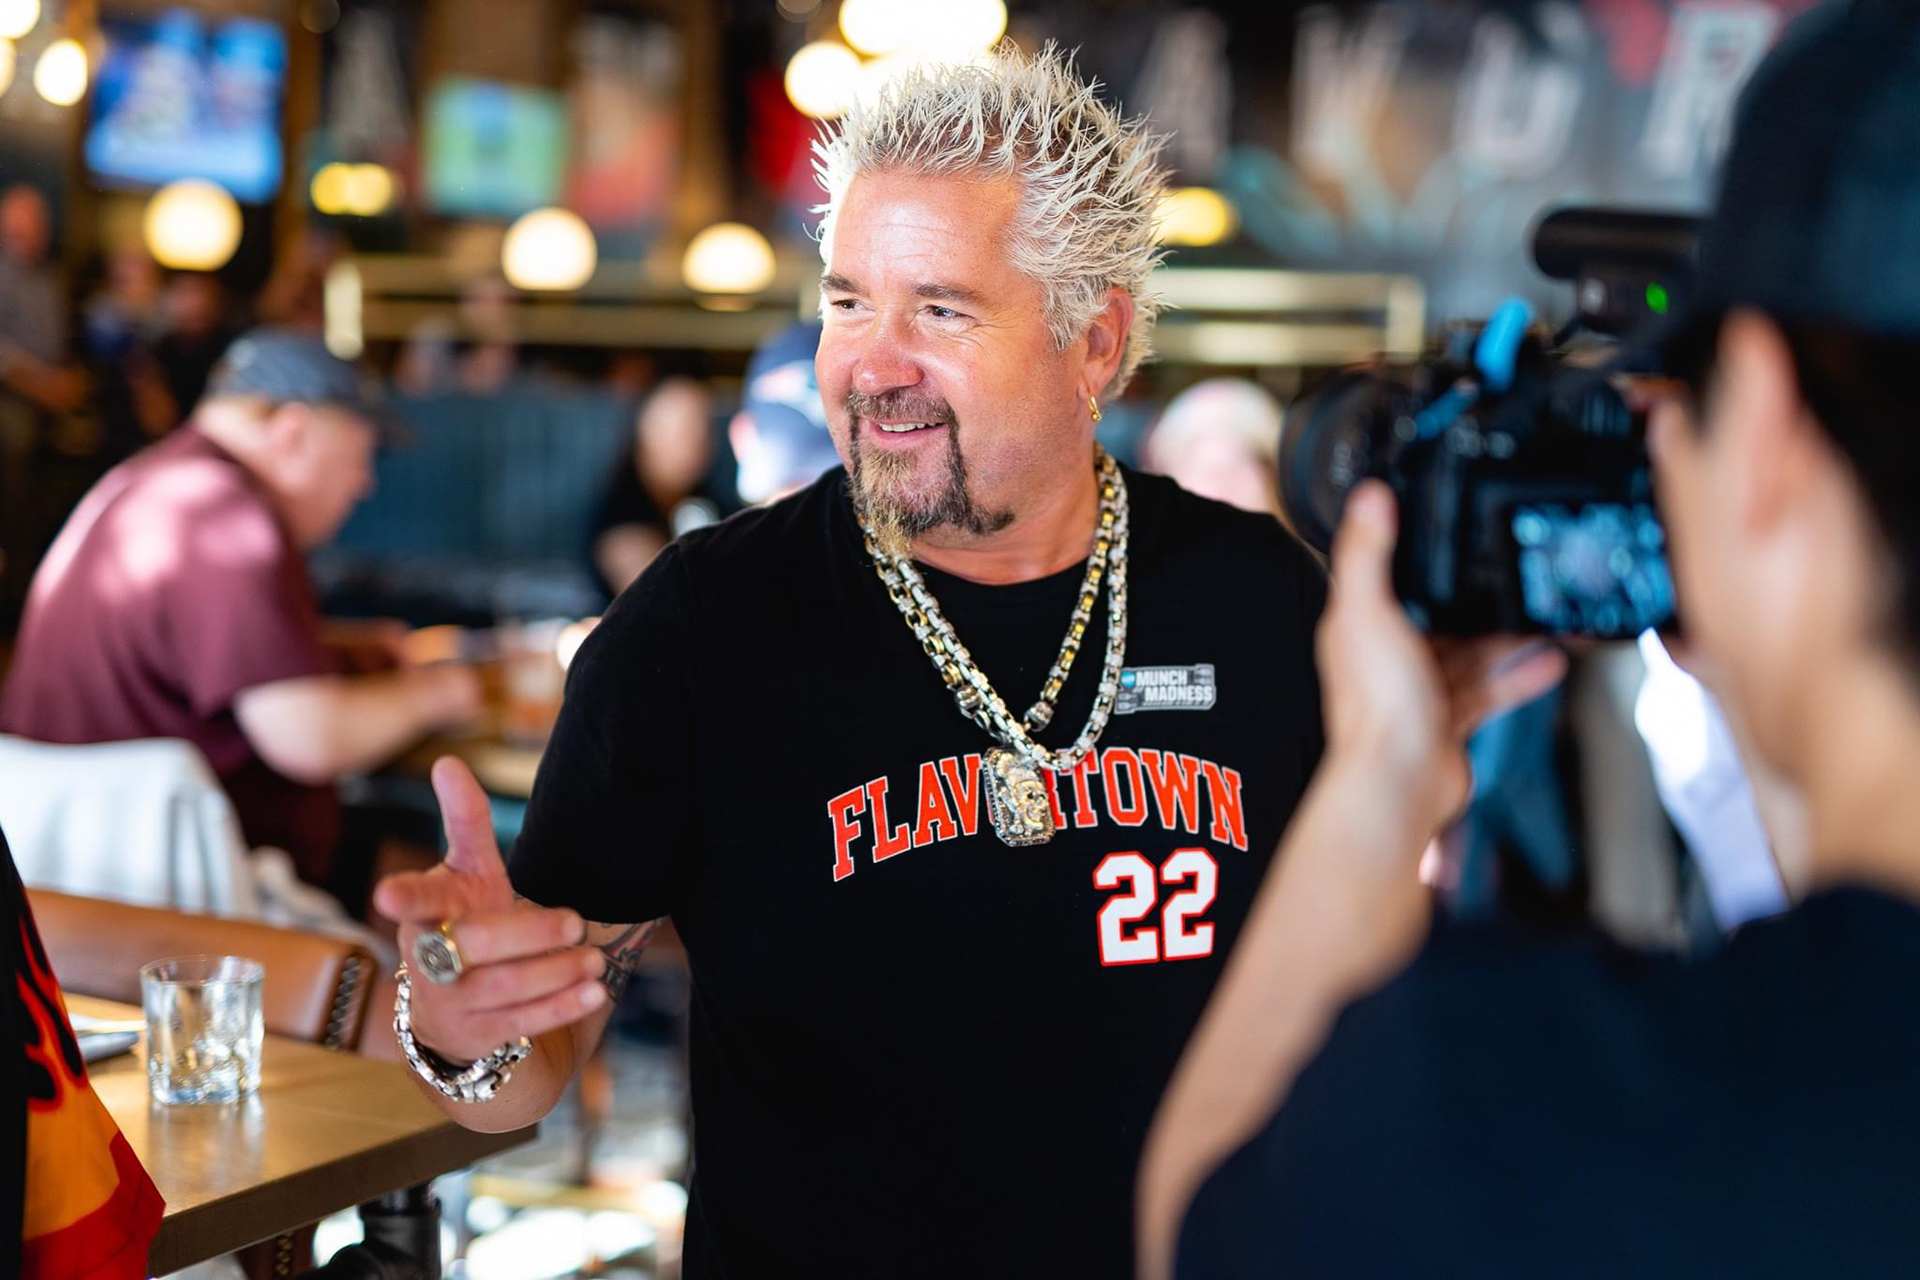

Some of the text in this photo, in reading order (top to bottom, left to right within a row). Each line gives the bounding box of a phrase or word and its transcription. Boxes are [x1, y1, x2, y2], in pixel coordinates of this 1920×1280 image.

[1136, 670, 1188, 686] MUNCH
[1144, 685, 1213, 702] MADNESS
[827, 747, 1248, 882] FLAVTOWN
[1093, 847, 1218, 966] 22
